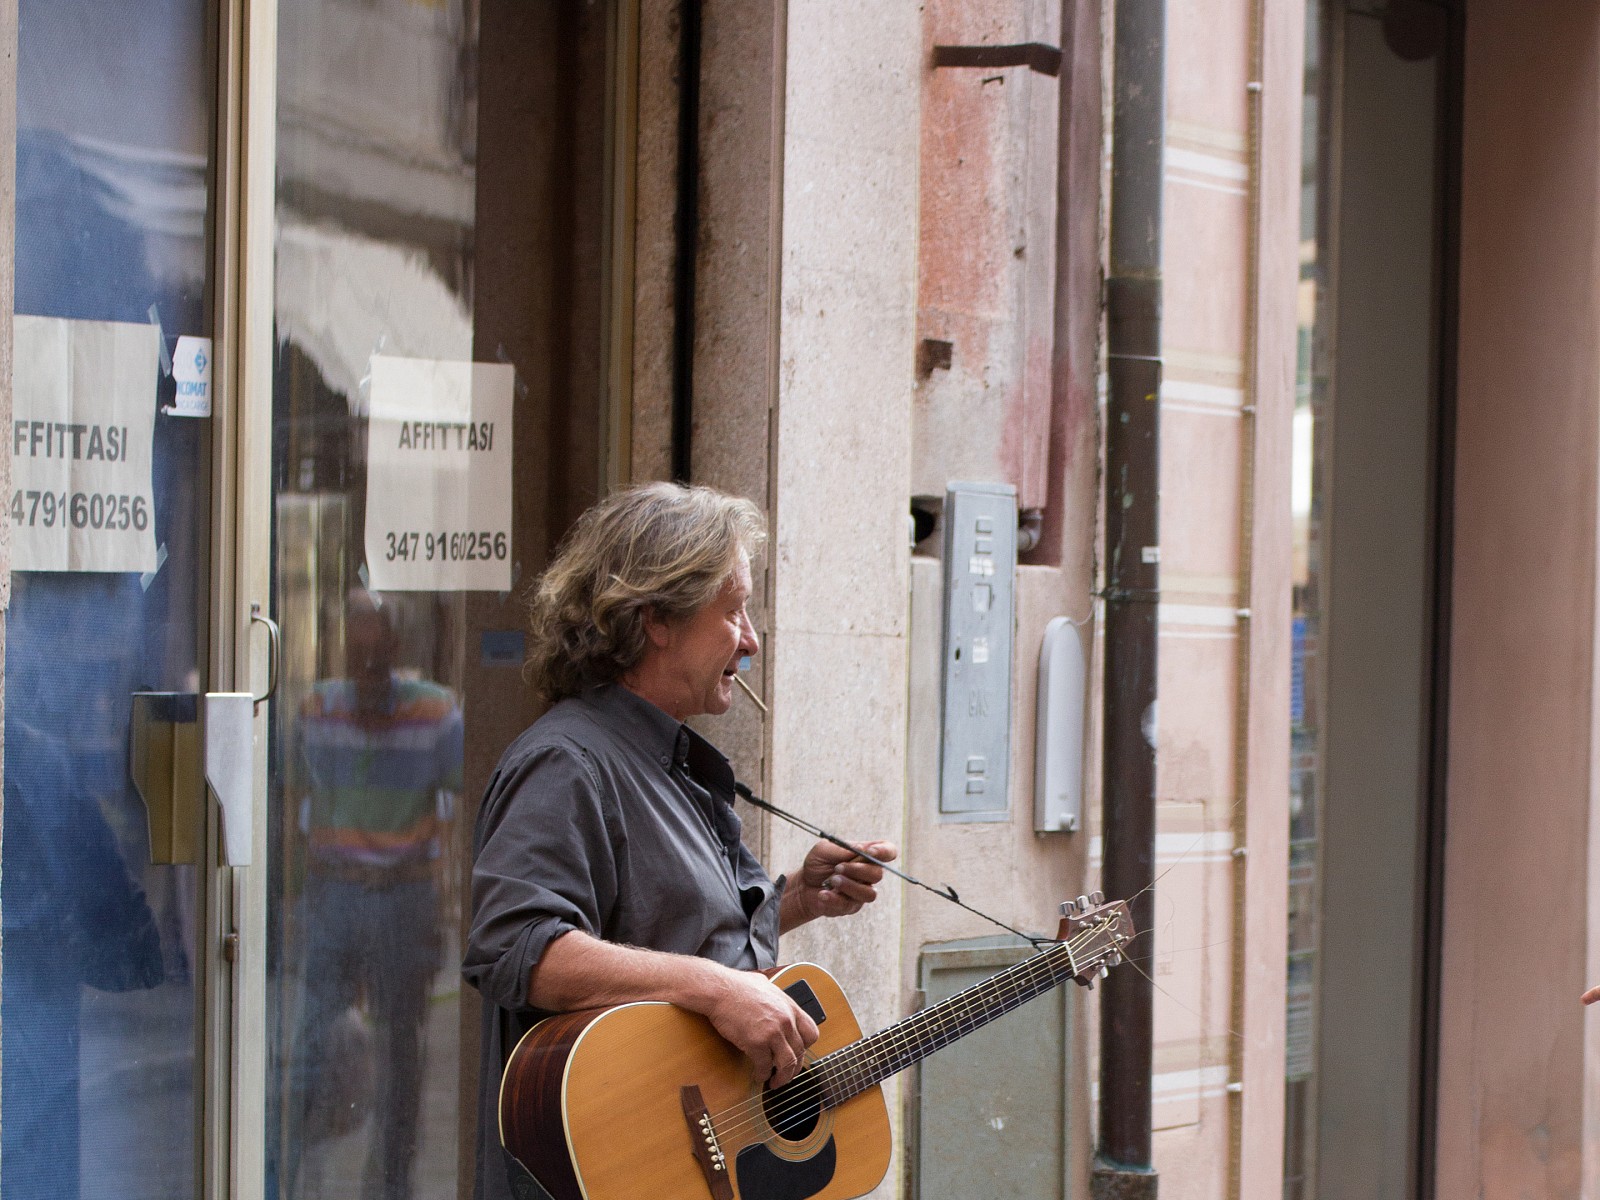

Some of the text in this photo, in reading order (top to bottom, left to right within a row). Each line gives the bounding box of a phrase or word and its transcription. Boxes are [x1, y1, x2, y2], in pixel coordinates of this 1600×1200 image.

[14, 420, 127, 462] FFITTASI
[399, 421, 494, 451] AFFITTASI
[11, 489, 148, 531] 479160256
